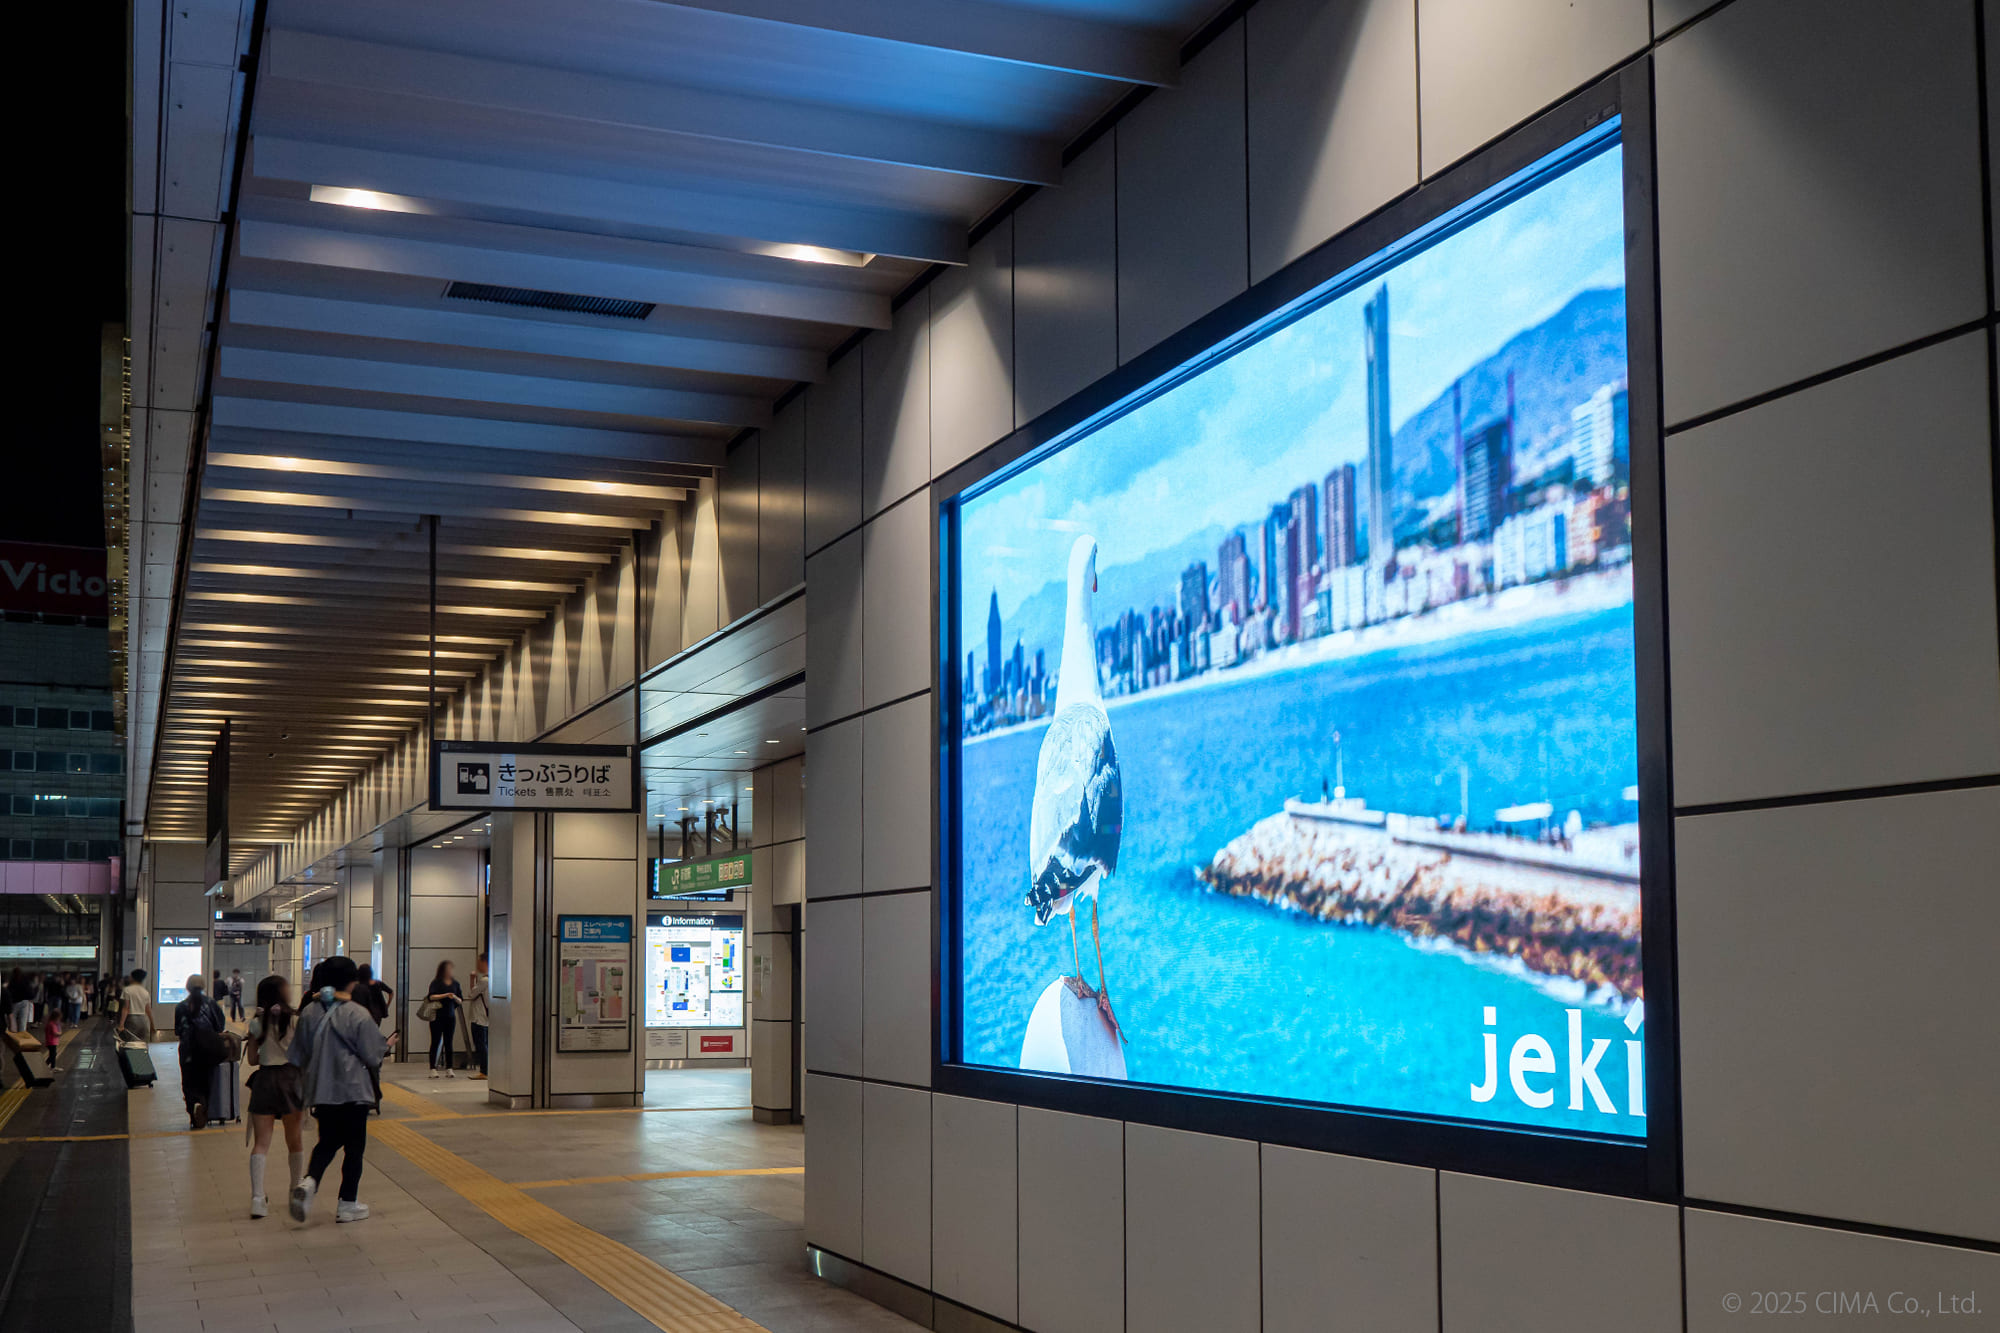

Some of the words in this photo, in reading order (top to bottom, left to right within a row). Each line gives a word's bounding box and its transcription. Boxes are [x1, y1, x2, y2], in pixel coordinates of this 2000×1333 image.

[498, 763, 611, 784] きっぷうりば
[498, 786, 537, 797] Tickets
[672, 916, 714, 926] Information
[1471, 996, 1647, 1117] jeki
